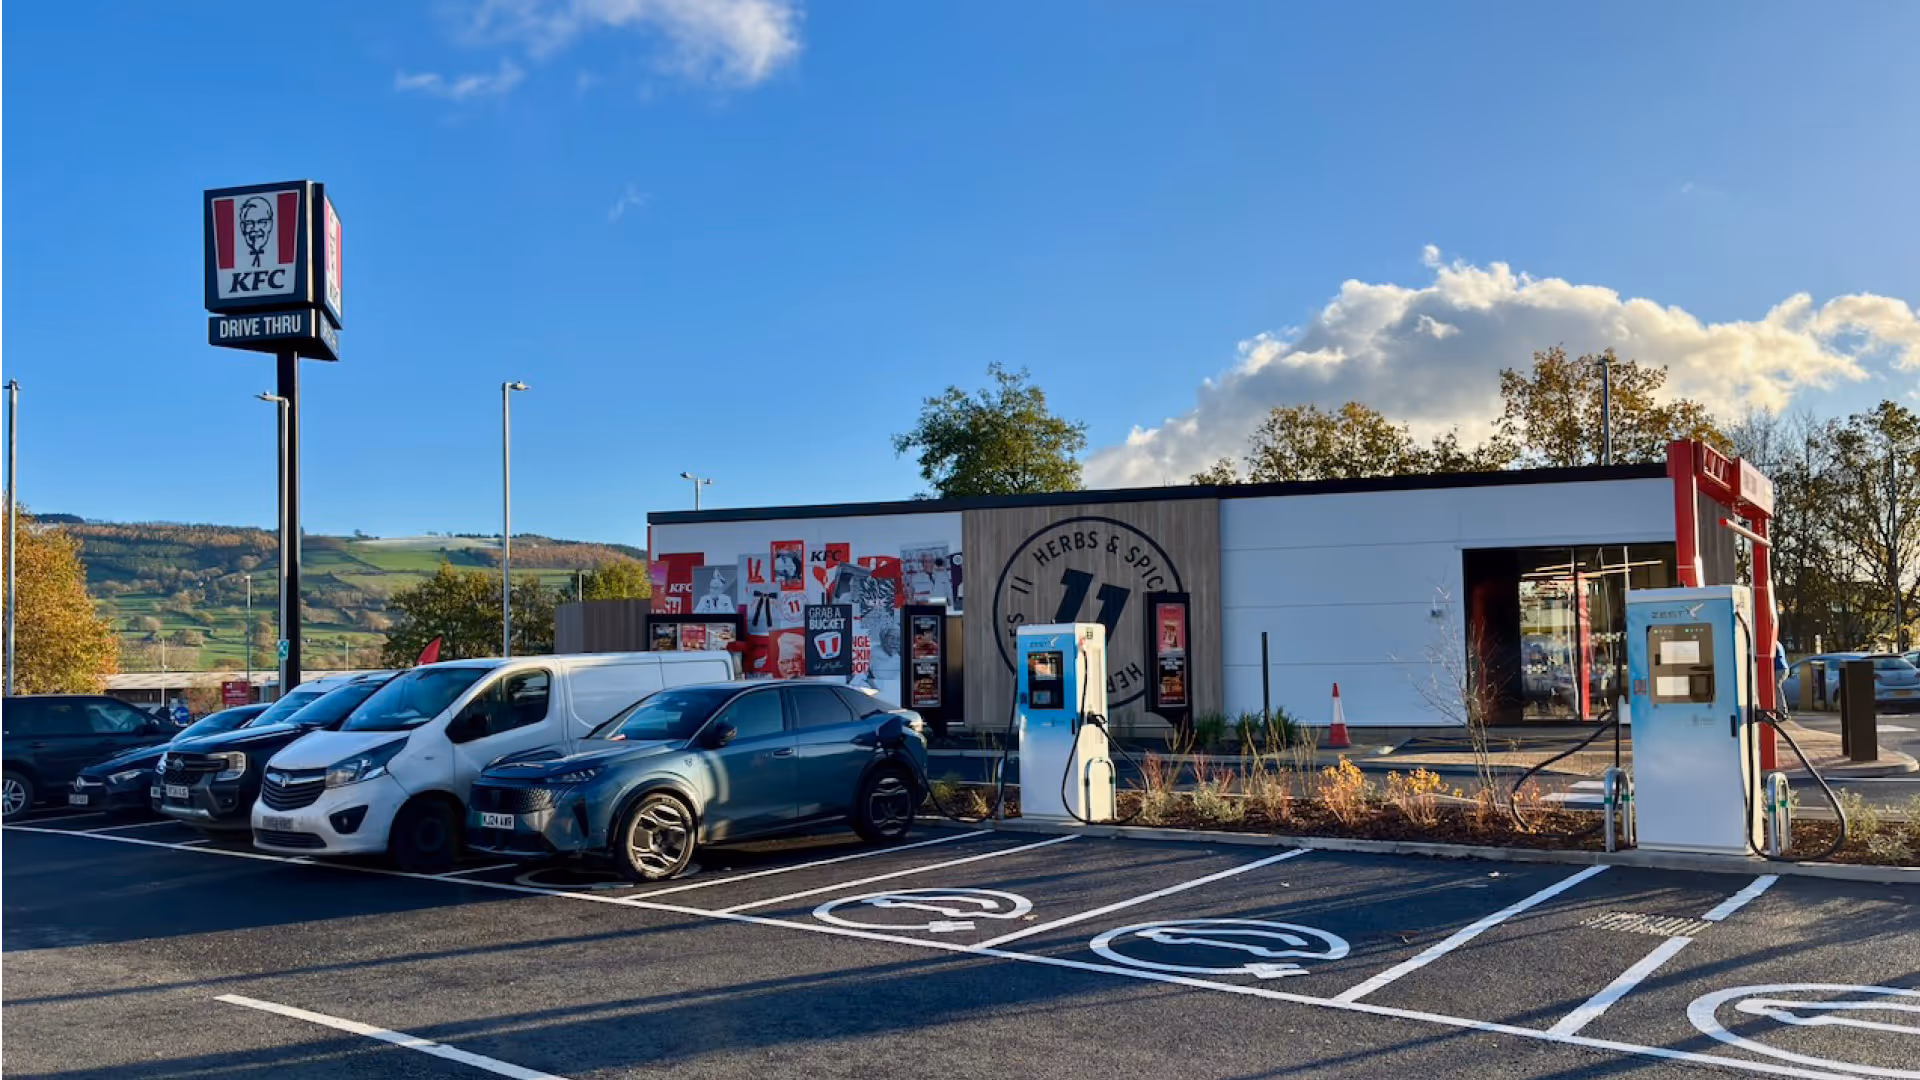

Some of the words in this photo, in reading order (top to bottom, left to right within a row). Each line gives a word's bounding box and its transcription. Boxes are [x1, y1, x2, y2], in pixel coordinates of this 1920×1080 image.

[229, 269, 286, 293] KFC
[219, 317, 261, 339] DRIVE
[263, 314, 302, 335] THRU
[809, 549, 842, 562] KFC
[1032, 531, 1099, 567] HERBS
[1106, 536, 1120, 554] &
[1124, 546, 1164, 590] SPIC
[808, 607, 833, 618] GRAB
[808, 617, 847, 630] BUCKET
